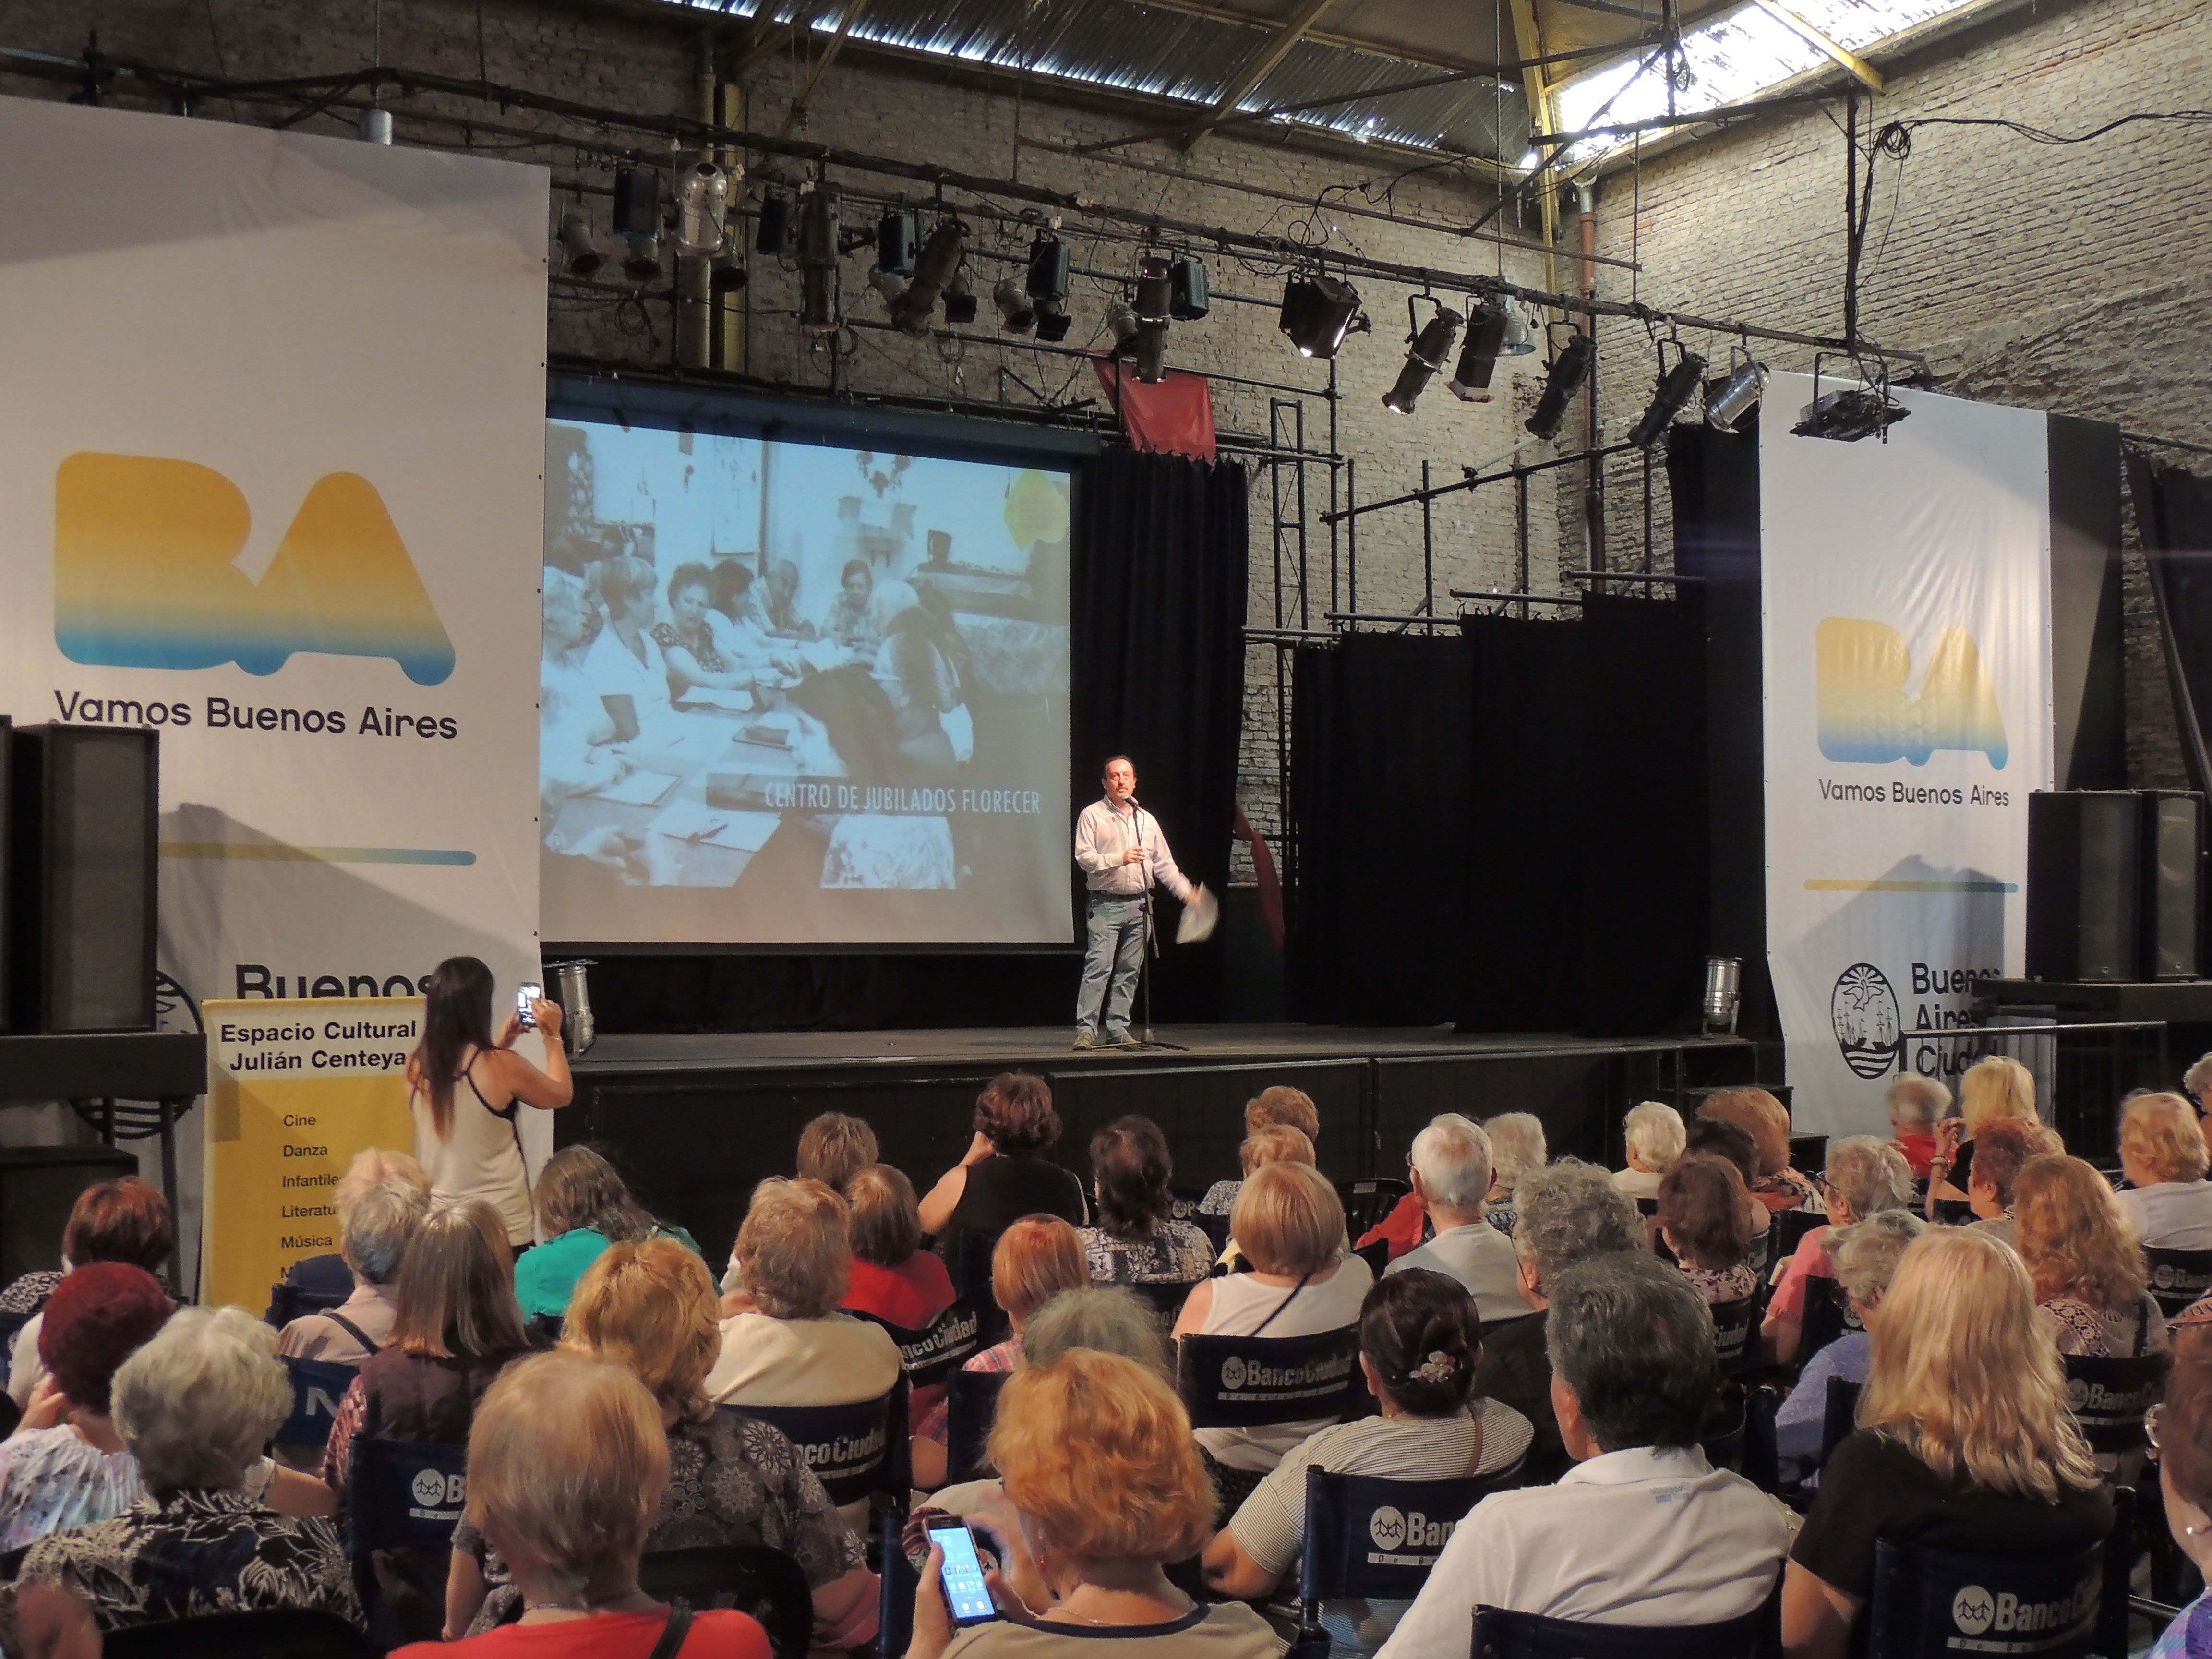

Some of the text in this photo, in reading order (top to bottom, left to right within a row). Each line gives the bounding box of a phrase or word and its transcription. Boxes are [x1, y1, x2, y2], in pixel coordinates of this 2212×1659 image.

[54, 690, 457, 740] Vamos Buenos Aires
[766, 783, 1040, 814] CENTRO DE JUBILADOS FLORECER
[1818, 779, 2009, 806] Vamos Buenos Aires
[1911, 962, 2001, 994] Buen
[1916, 1004, 1973, 1029] Aire
[221, 1020, 416, 1046] Espacio Cultural
[230, 1050, 407, 1070] Julián Centeya
[284, 1114, 316, 1127] Cine
[283, 1145, 328, 1157] Danza
[282, 1173, 341, 1188] Infantile
[282, 1205, 337, 1218] Literatu
[281, 1235, 333, 1249] Música
[901, 1310, 977, 1359] ncoCiudad
